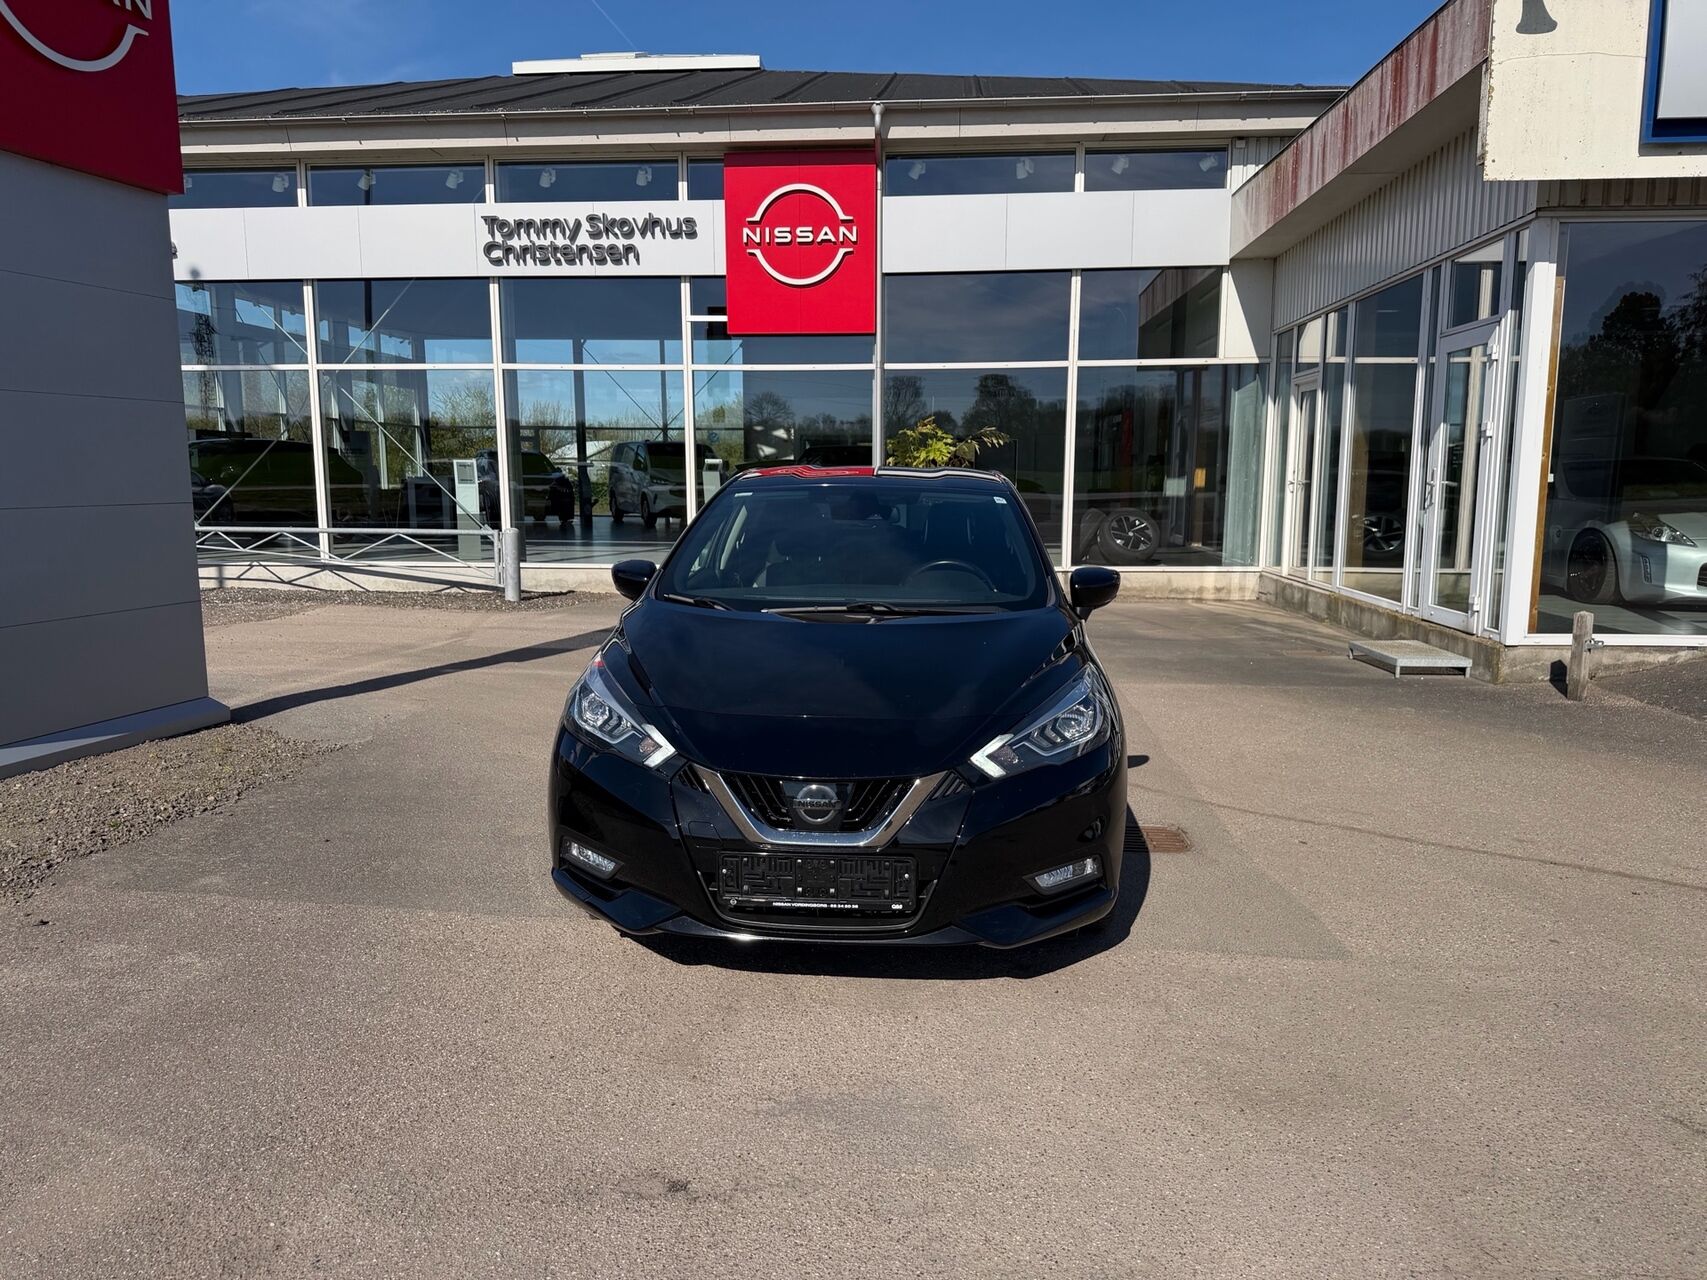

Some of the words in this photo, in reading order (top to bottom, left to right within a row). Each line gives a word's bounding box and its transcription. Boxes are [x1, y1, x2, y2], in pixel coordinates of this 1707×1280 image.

[481, 215, 583, 245] Tommy
[585, 213, 698, 240] Skovhus
[743, 225, 858, 245] NISSAN
[483, 240, 641, 266] Christensen
[798, 800, 837, 809] NISSAN
